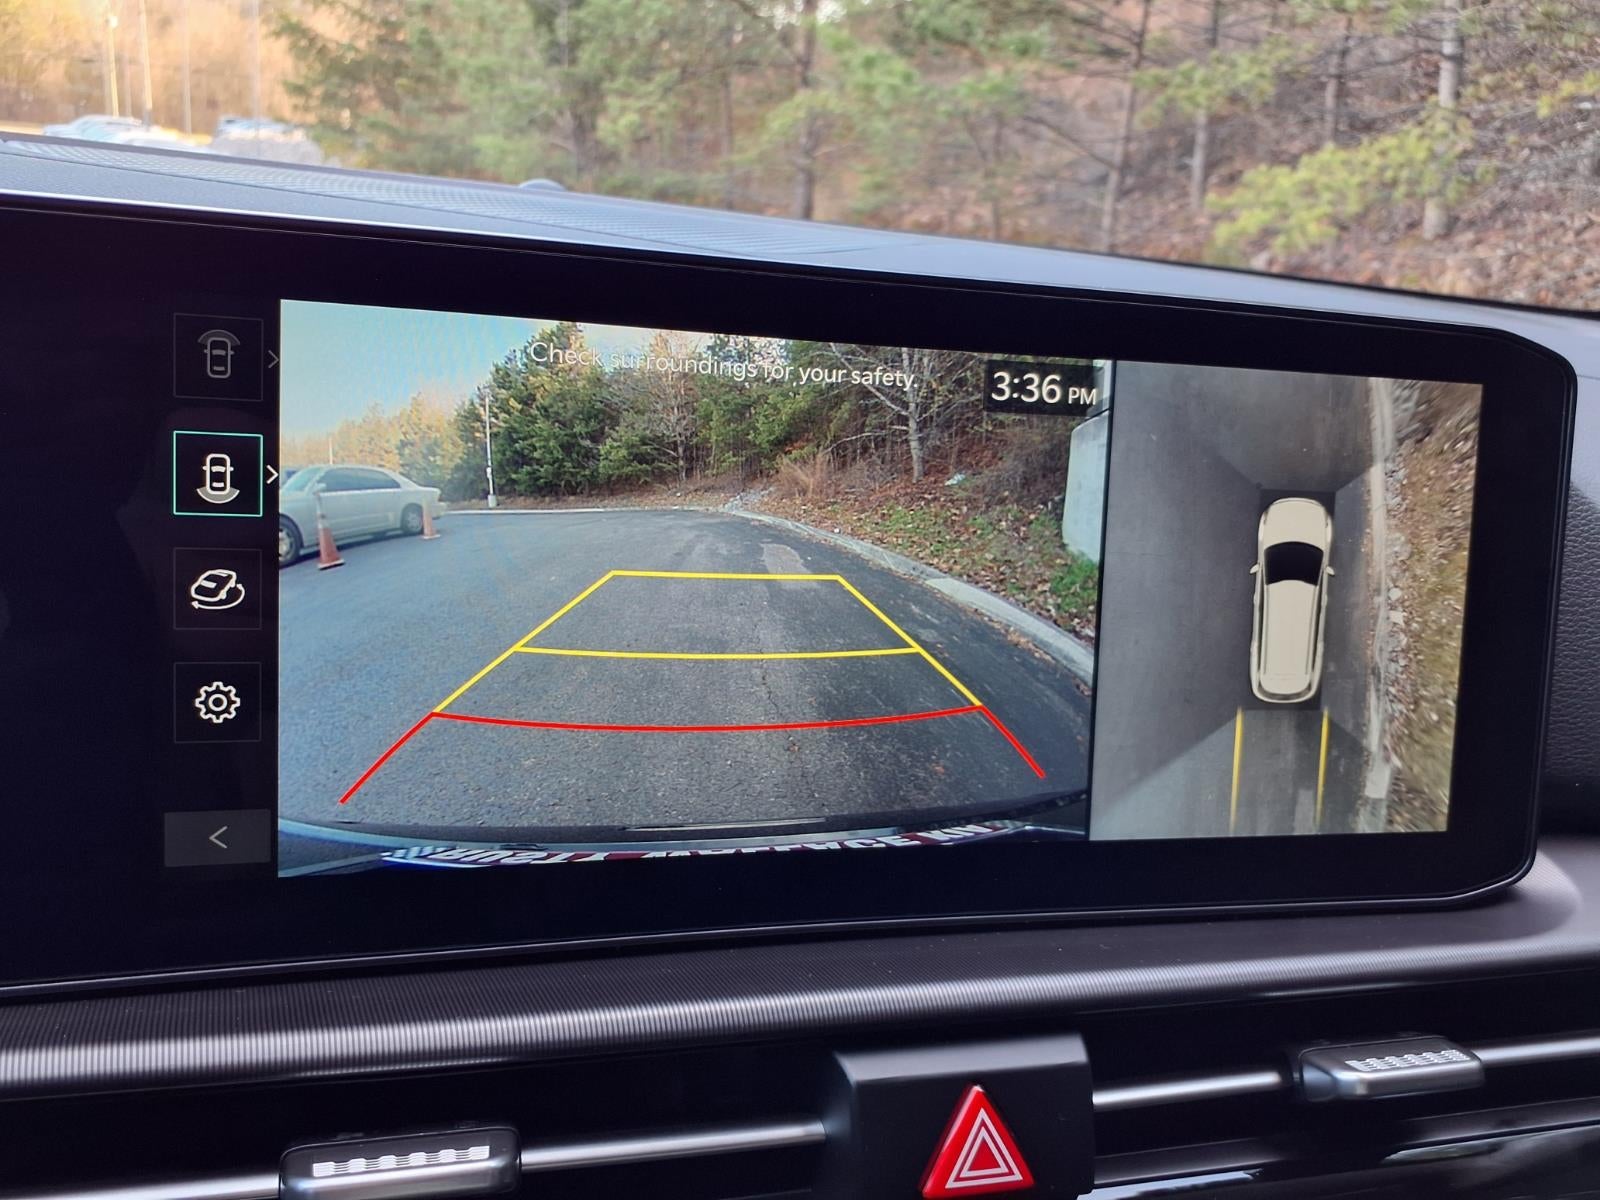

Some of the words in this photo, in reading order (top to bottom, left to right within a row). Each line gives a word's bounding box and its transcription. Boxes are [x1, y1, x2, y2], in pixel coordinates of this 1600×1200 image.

[530, 342, 603, 367] Check
[610, 352, 757, 382] surroundings
[762, 361, 795, 379] for
[799, 366, 848, 385] your
[850, 366, 918, 391] safety.
[991, 371, 1062, 404] 3:36
[1068, 387, 1097, 406] PM
